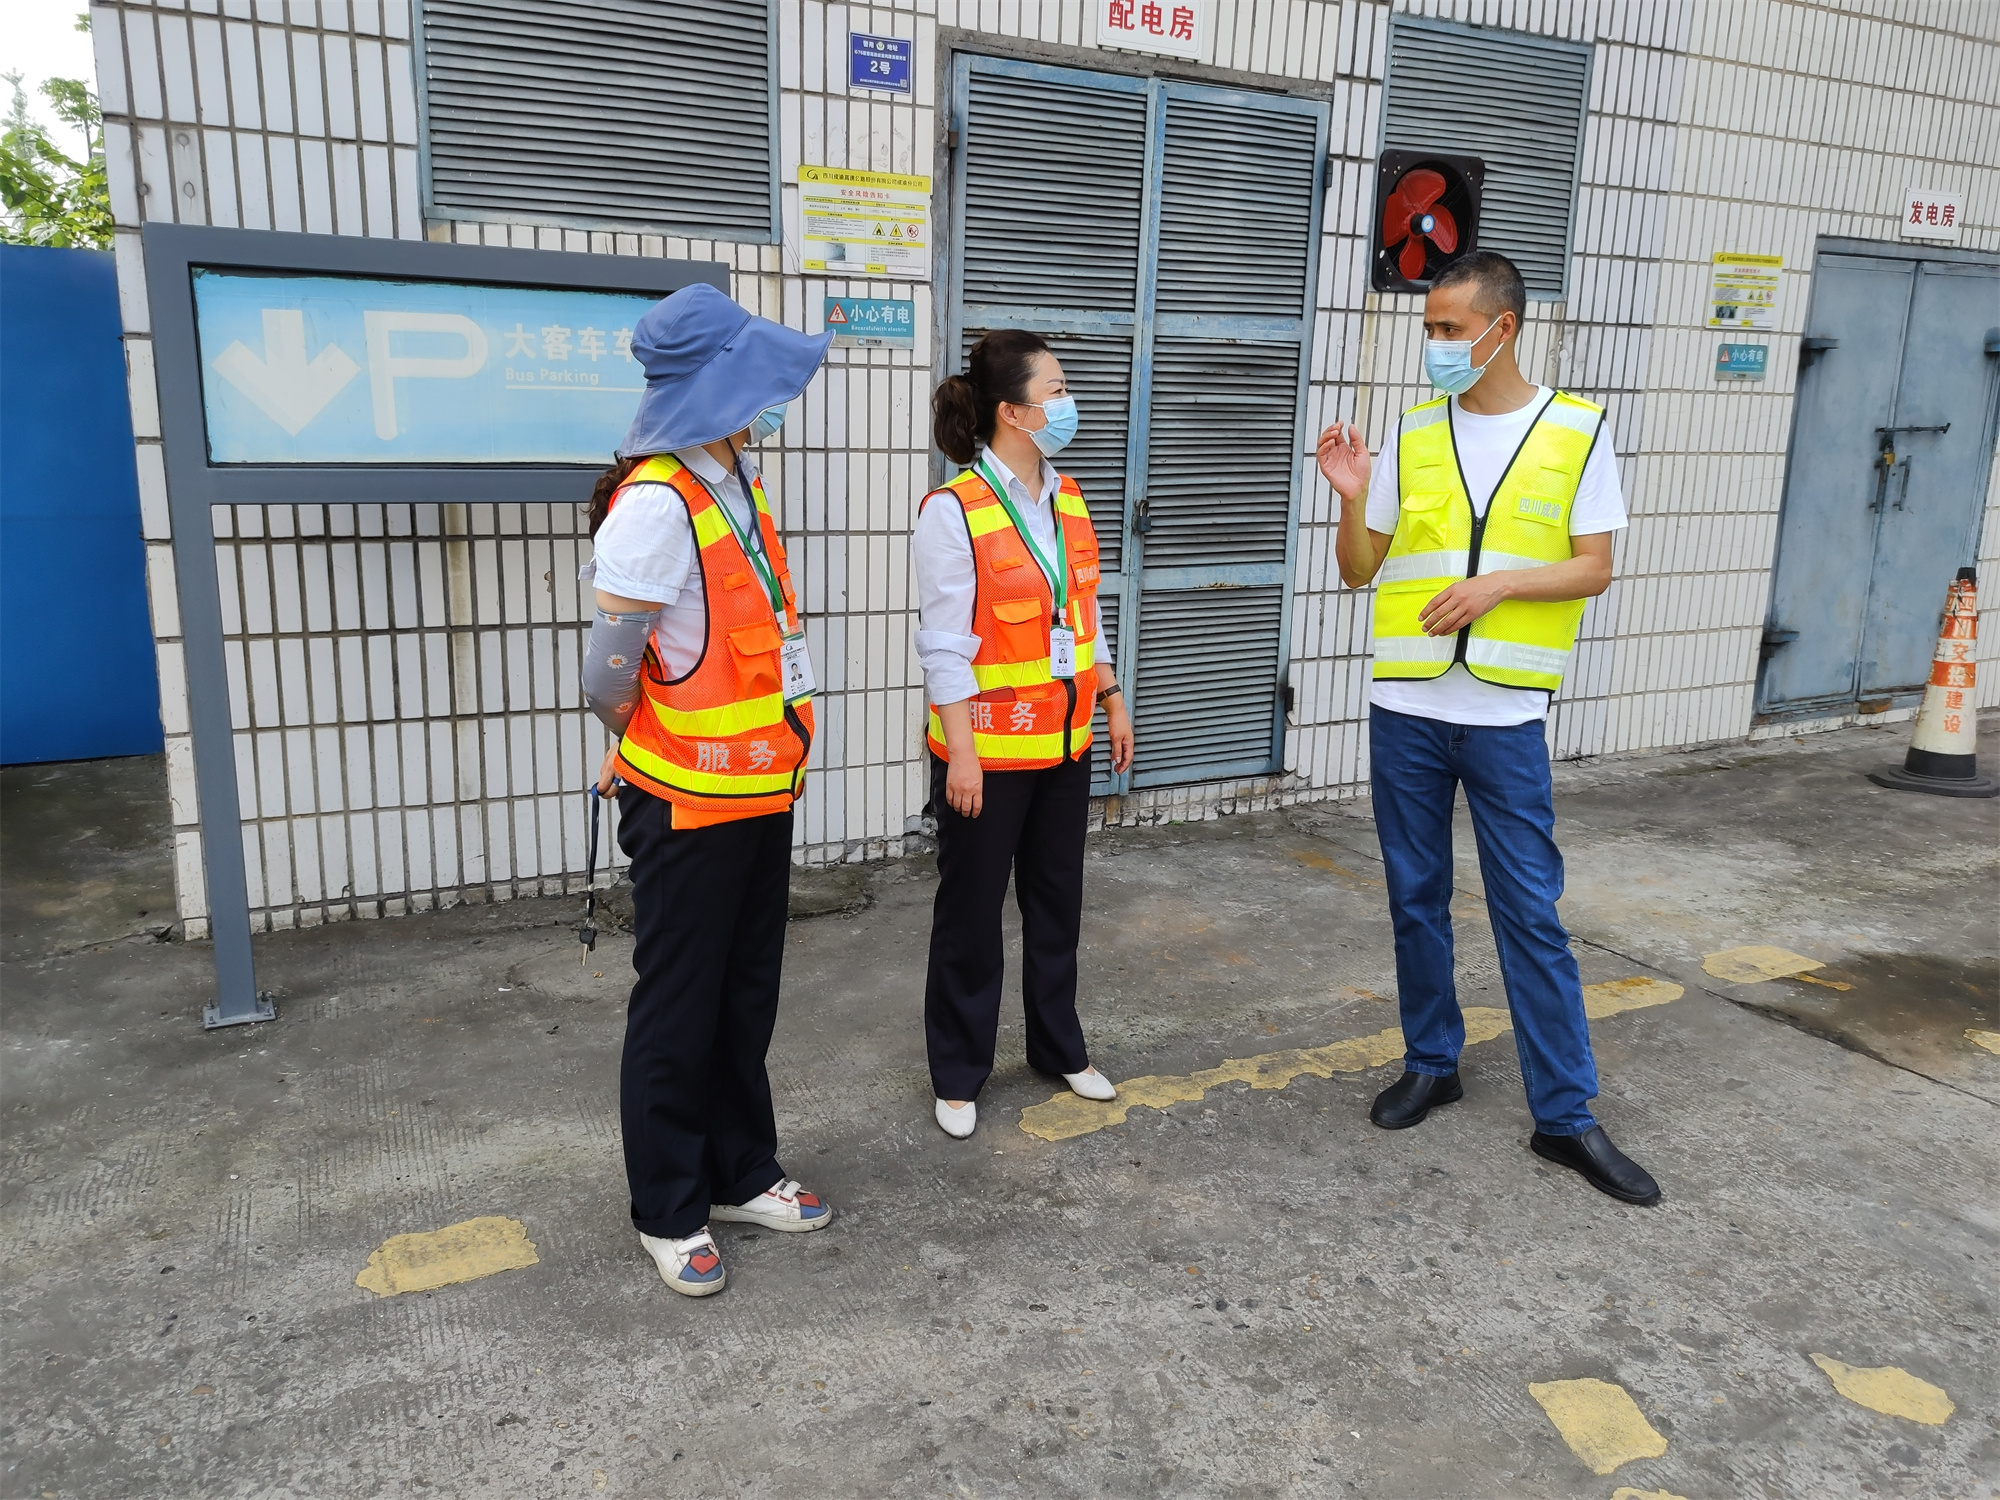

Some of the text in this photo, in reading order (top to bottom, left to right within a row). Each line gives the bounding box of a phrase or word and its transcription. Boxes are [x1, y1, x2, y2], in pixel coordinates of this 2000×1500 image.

[1109, 0, 1195, 41] 配电房
[870, 60, 891, 75] 2号
[840, 189, 891, 200] 安全风险告知卡
[1909, 201, 1955, 227] 发电房
[850, 304, 910, 324] 小心有电
[1731, 349, 1764, 363] 小心有电
[363, 310, 488, 441] P
[505, 367, 599, 386] Bus Parking
[1518, 497, 1562, 520] 四川成渝
[969, 701, 1037, 731] 服务
[695, 740, 777, 771] 服务
